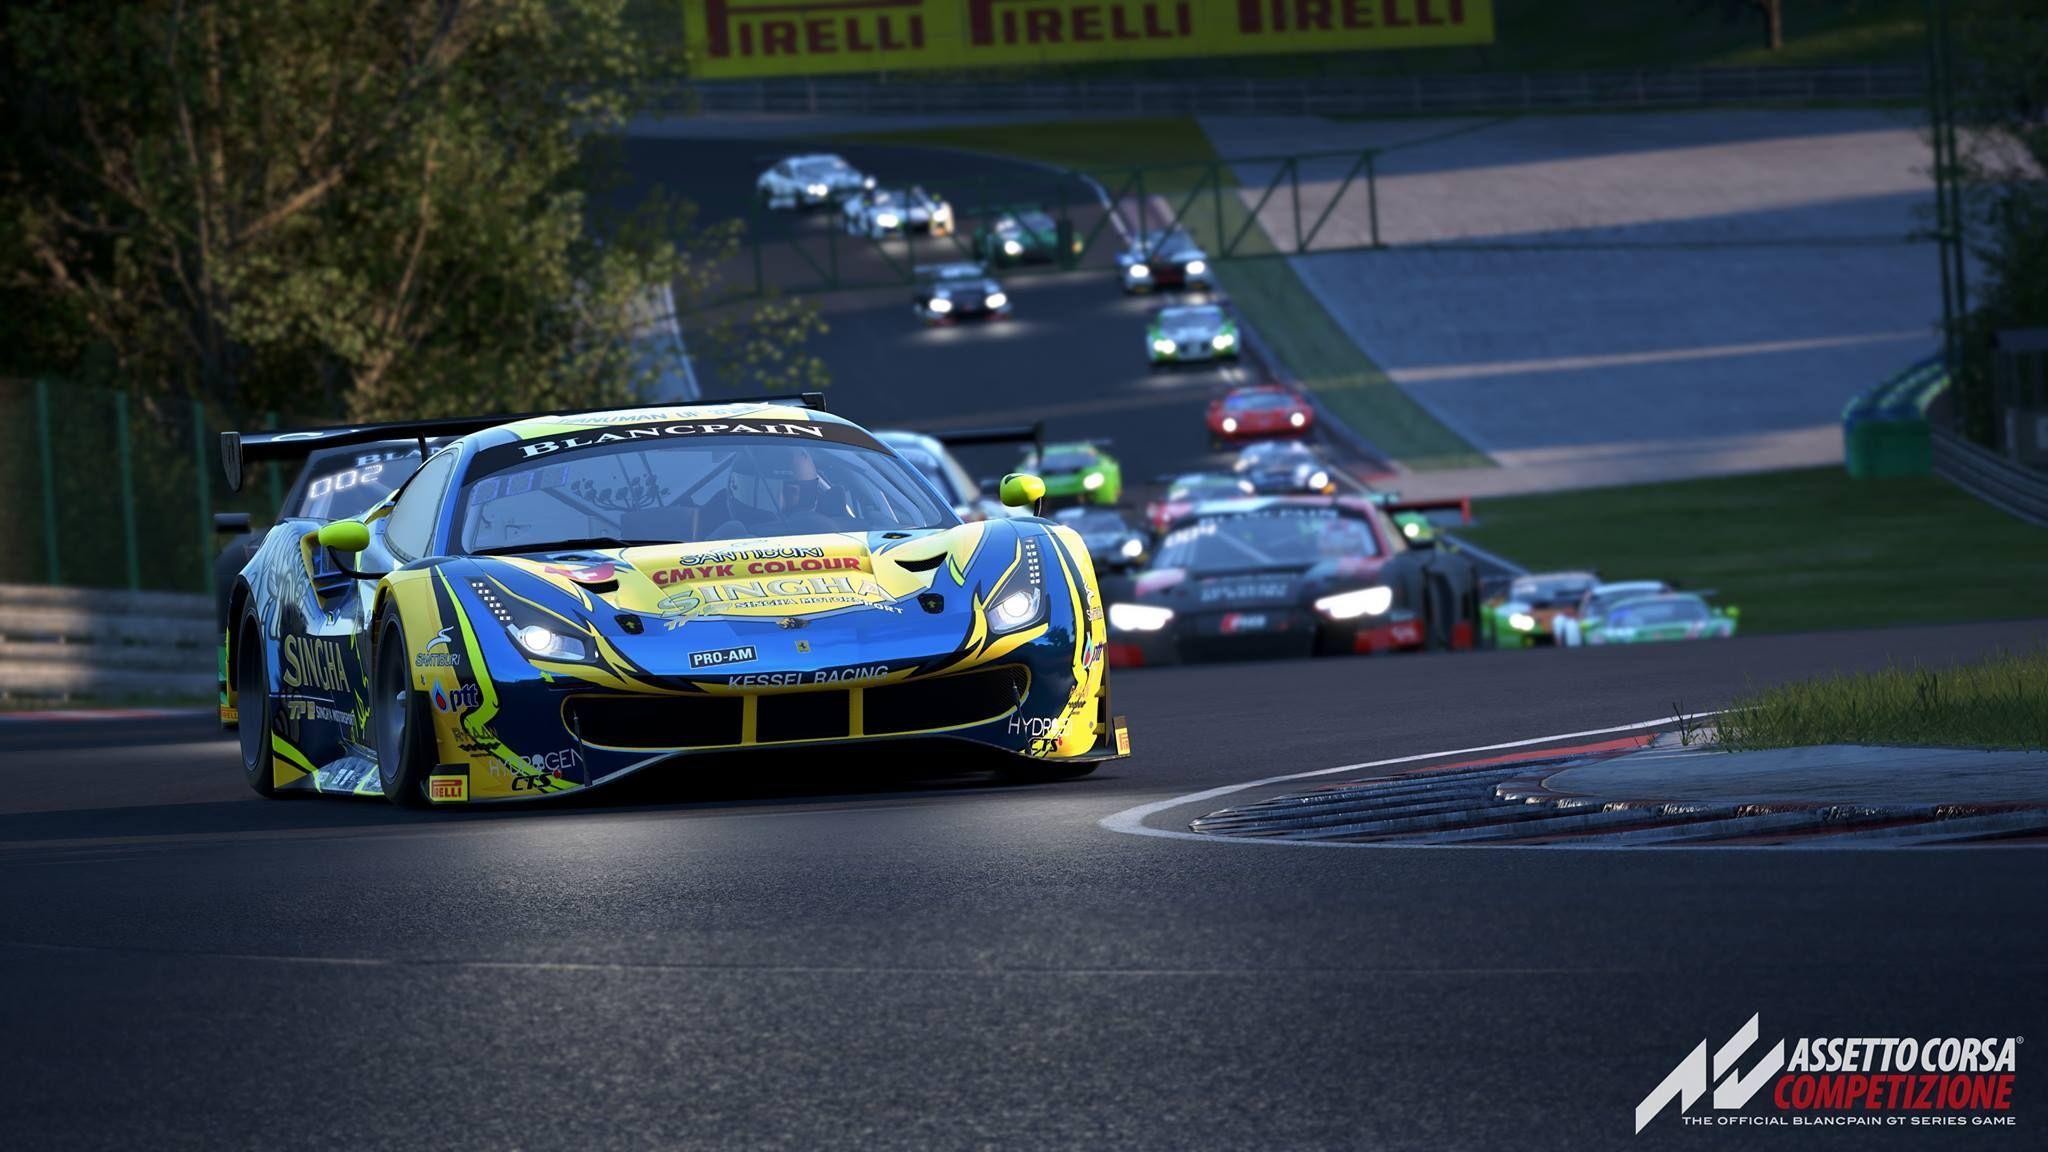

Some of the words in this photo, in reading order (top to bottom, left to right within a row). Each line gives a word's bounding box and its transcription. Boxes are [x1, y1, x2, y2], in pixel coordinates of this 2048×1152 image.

[519, 423, 824, 459] BLANCPAIN
[652, 564, 735, 586] CMYK
[747, 557, 862, 575] COLOUR
[657, 576, 899, 617] SINGHA
[283, 634, 351, 693] SINGHA
[693, 647, 753, 667] PRO-AM
[728, 673, 803, 689] KESSEL
[814, 665, 889, 684] RACING
[449, 683, 480, 713] ptt
[511, 772, 552, 792] CTS
